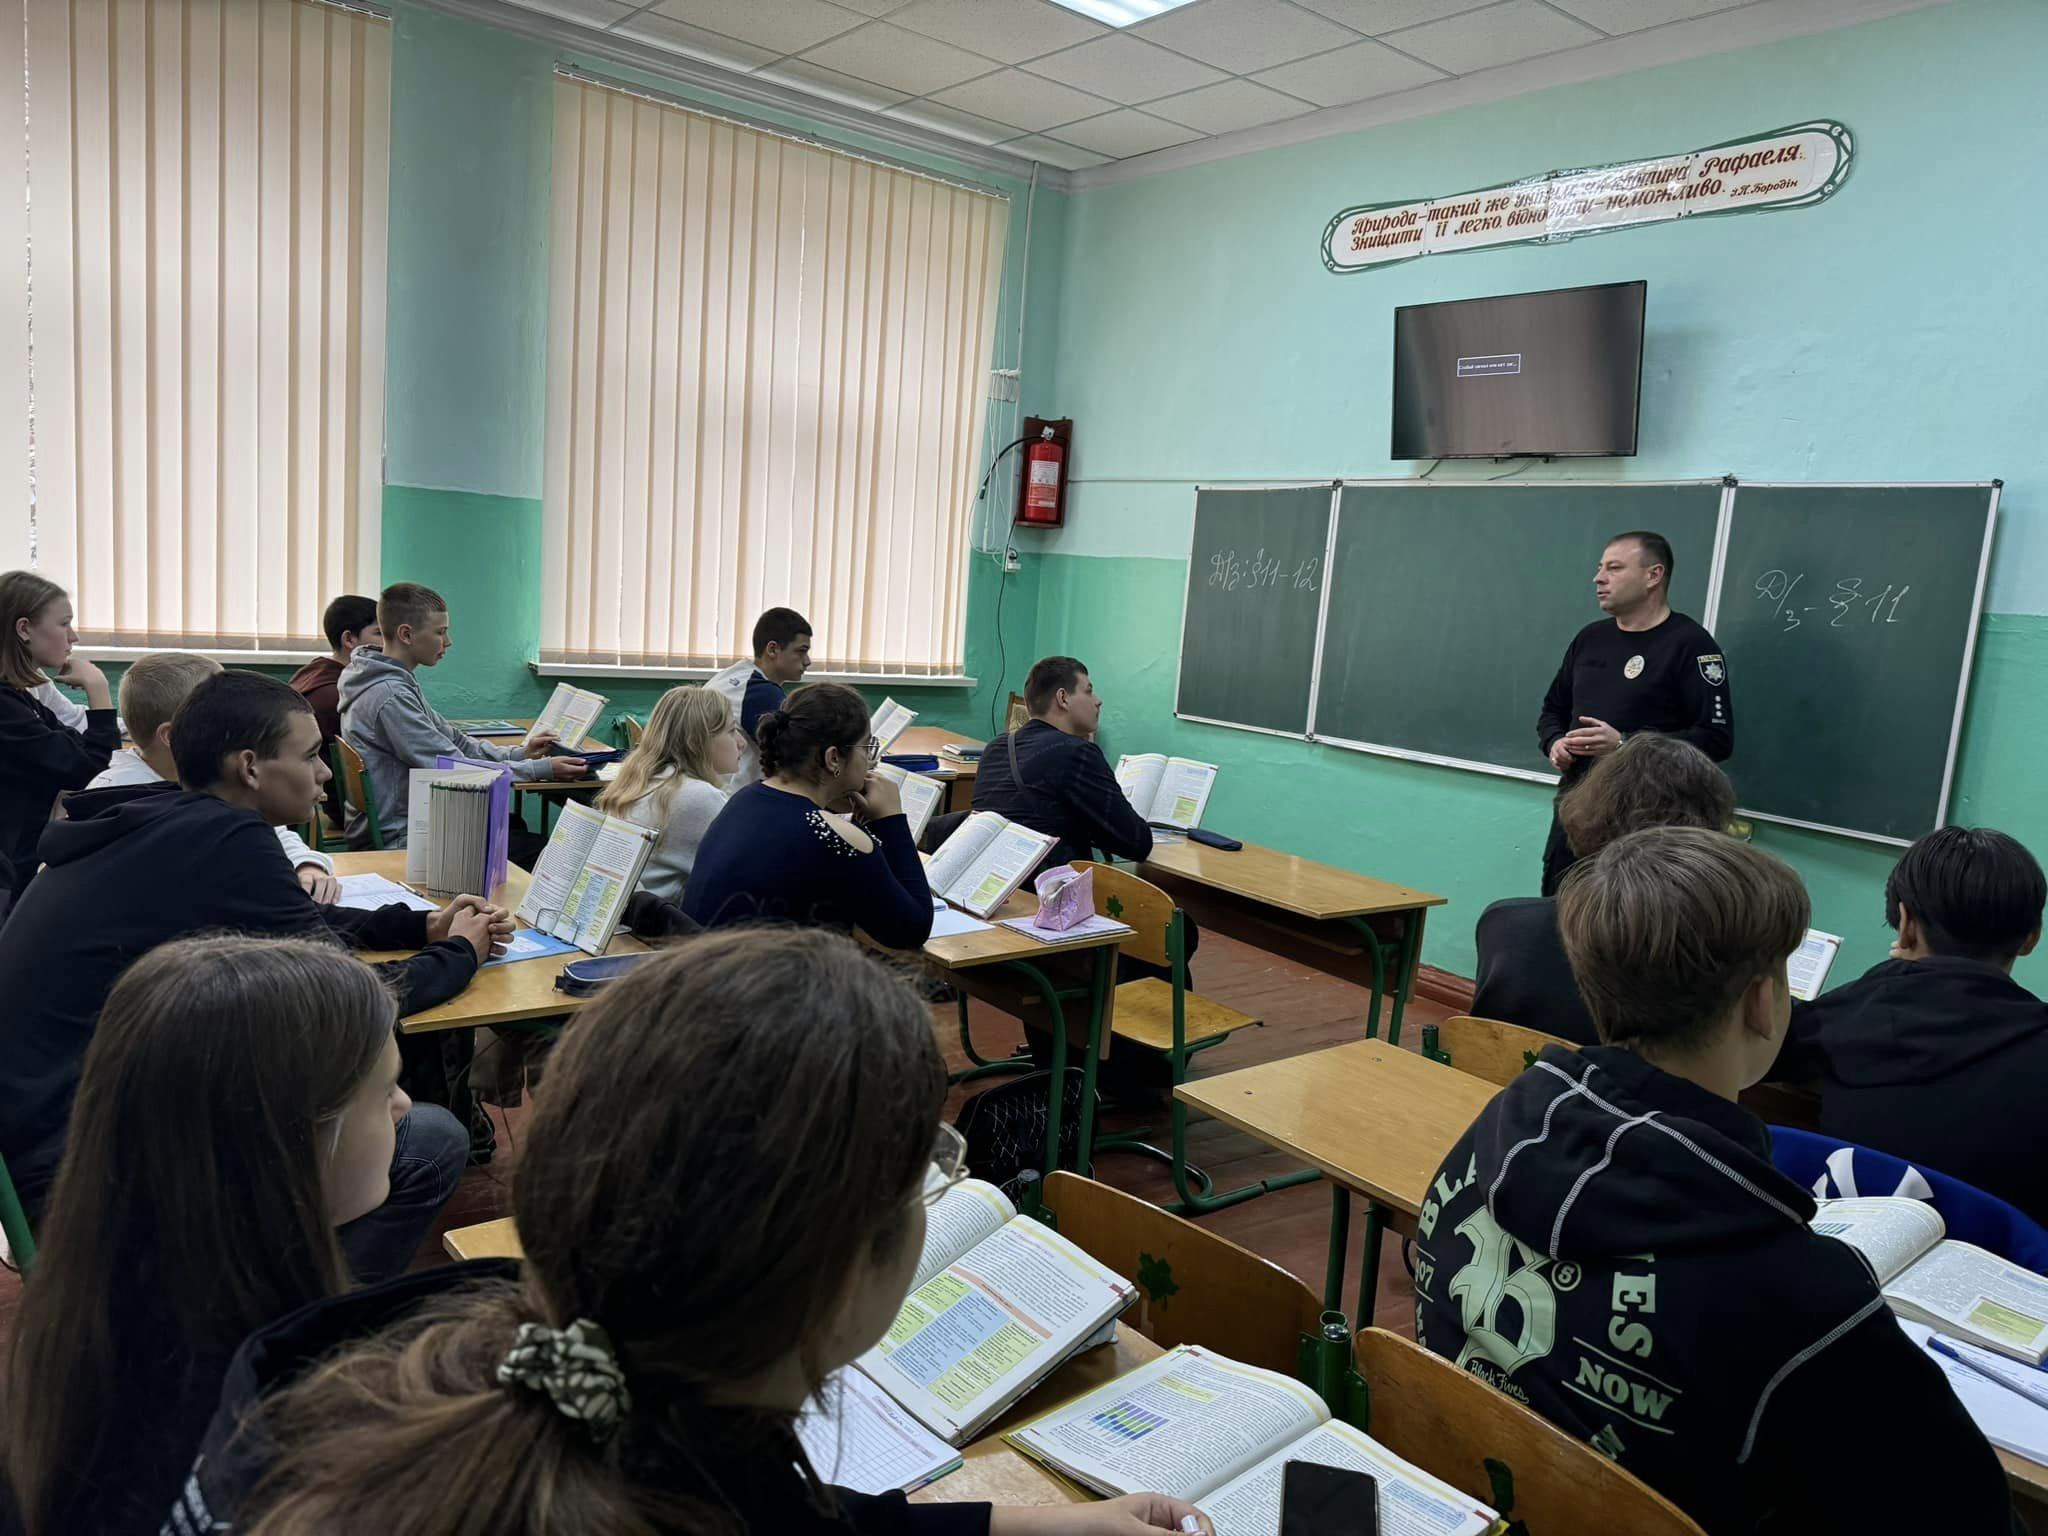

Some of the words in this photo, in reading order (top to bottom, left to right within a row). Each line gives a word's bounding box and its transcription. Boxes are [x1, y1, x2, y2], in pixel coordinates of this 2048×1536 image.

[1484, 196, 1510, 214] же
[1350, 227, 1423, 252] Знищити
[1434, 220, 1449, 238] її
[1470, 1359, 1496, 1386] Black
[1576, 1355, 1675, 1420] NOW
